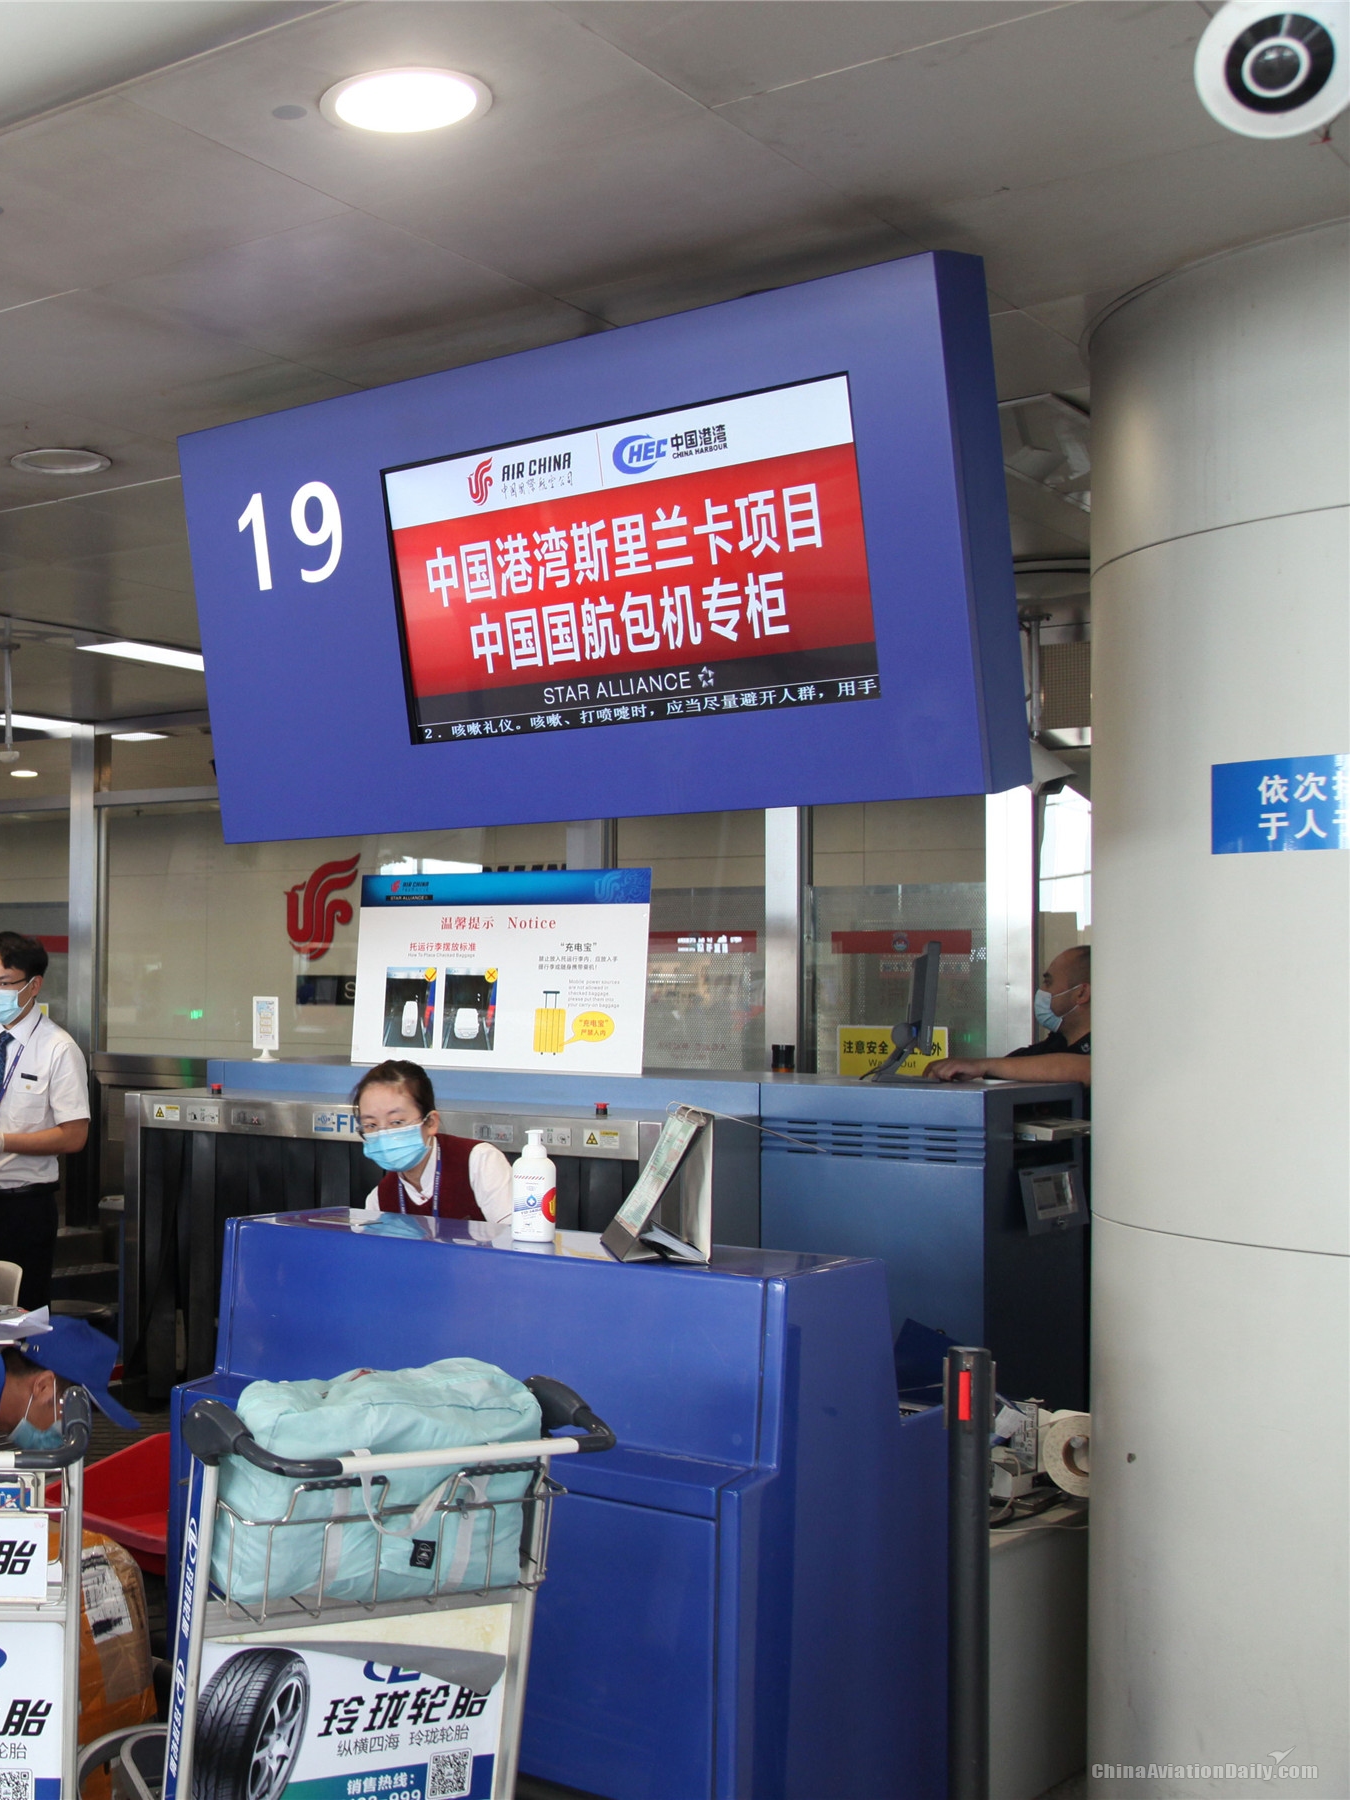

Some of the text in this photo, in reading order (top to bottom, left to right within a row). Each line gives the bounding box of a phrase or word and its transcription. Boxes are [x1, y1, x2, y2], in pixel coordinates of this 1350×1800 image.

[670, 424, 727, 451] 中国港湾
[672, 442, 728, 460] CHINA HARBOUR
[501, 452, 572, 482] AIR CHINA
[237, 480, 344, 593] 19
[425, 483, 824, 608] 中国港湾斯里兰卡项目
[469, 571, 791, 675] 中国国航包机专柜
[543, 671, 692, 705] STAR ALLIANCE
[441, 916, 556, 930] 温馨提示 Notice
[409, 942, 477, 952] 托运行李摆放标准
[843, 1040, 889, 1055] 注意安全
[318, 1684, 491, 1738] 玲珑轮胎
[337, 1725, 470, 1758] 纵横四海 玲珑轮胎
